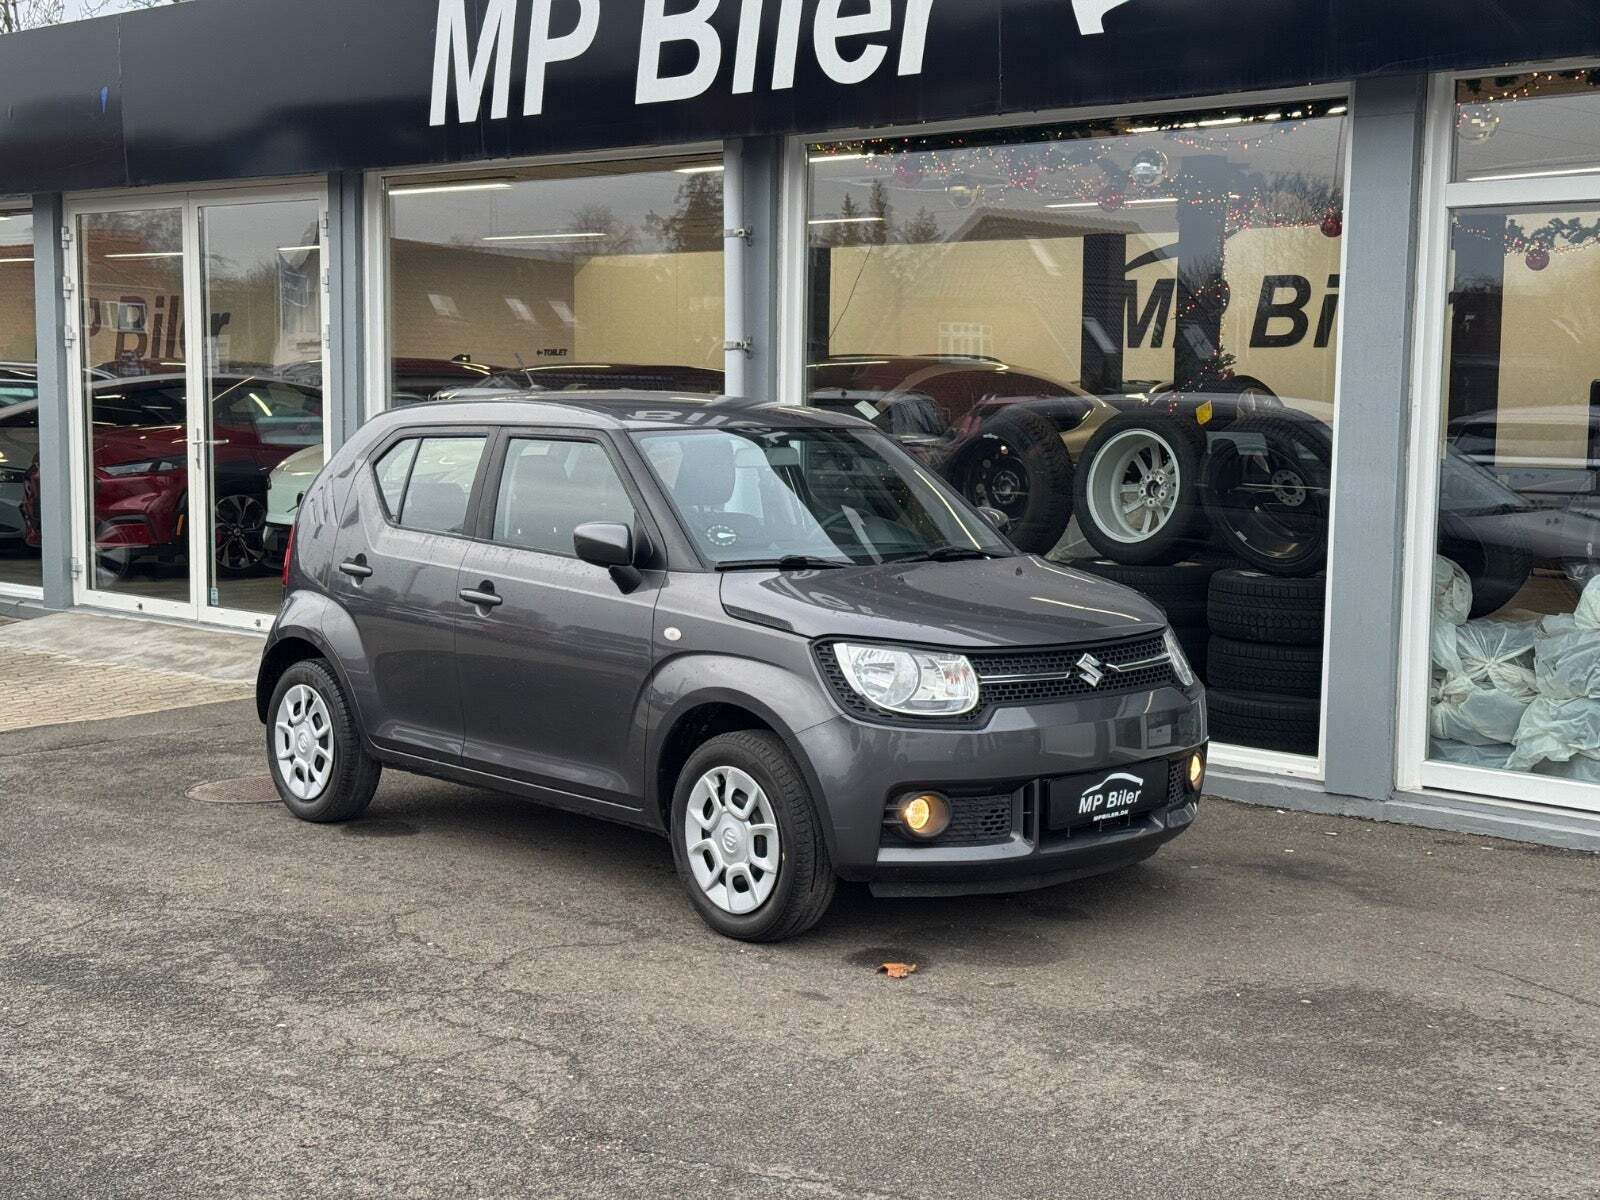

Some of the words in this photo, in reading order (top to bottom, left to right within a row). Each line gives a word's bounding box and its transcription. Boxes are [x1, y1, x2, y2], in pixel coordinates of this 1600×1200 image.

[429, 0, 600, 126] MP
[1078, 794, 1104, 814] MP
[1106, 789, 1142, 808] Biler
